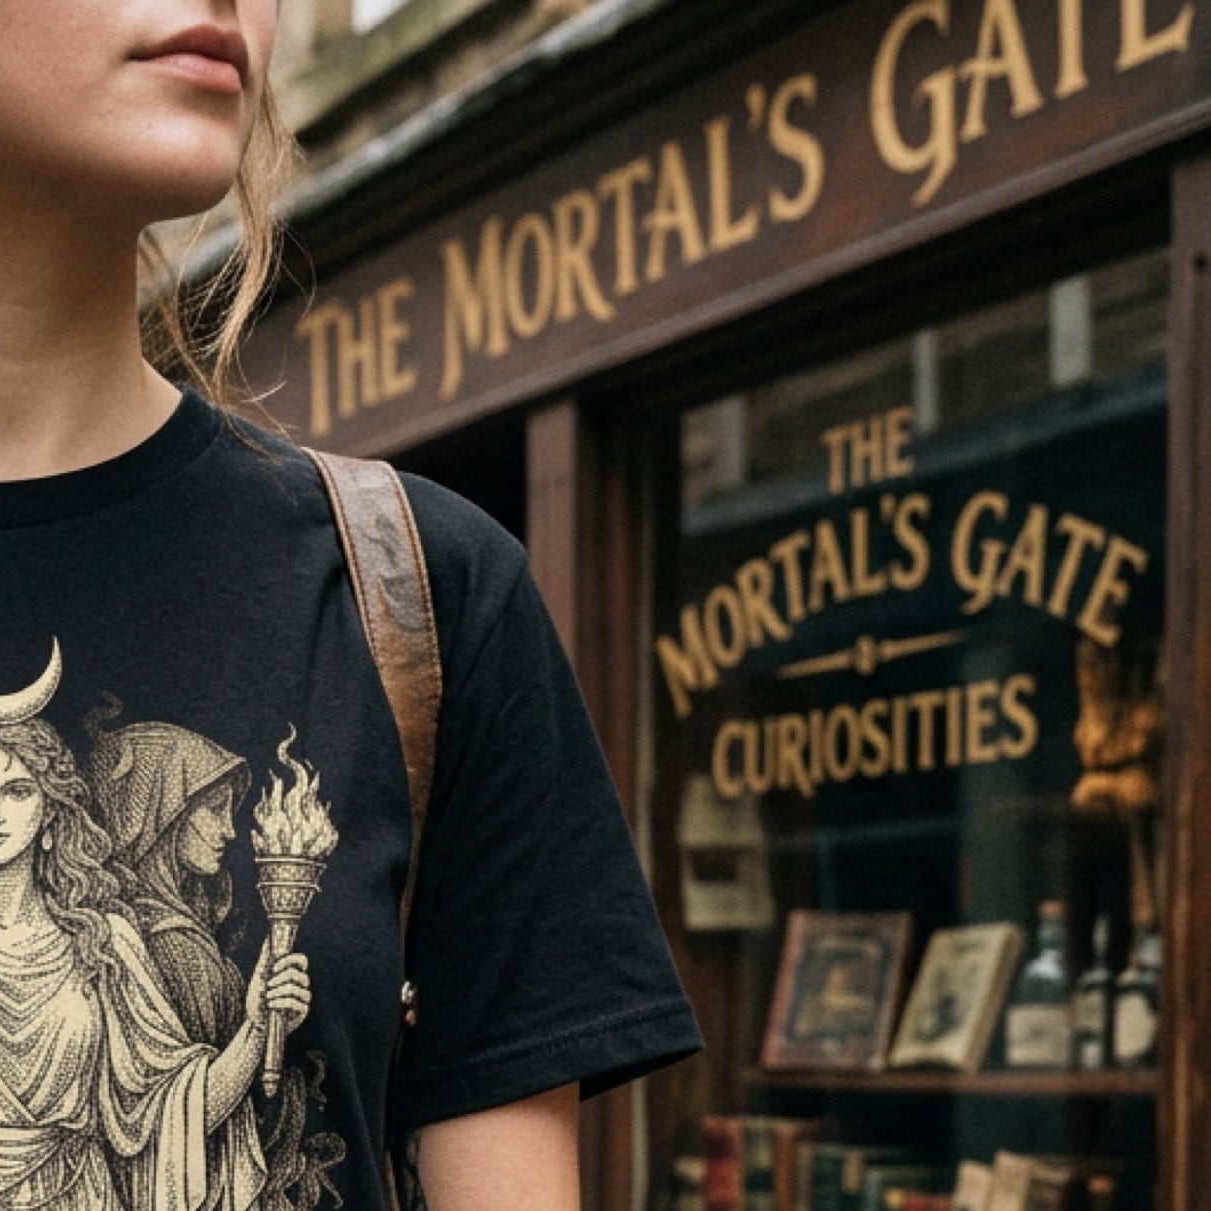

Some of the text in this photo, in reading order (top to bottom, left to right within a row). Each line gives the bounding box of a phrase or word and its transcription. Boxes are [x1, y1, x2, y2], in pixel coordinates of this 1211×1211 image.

[297, 277, 417, 436] THE
[438, 72, 826, 401] MORTAL'S
[822, 408, 915, 494] THE
[656, 491, 1149, 718] MORTAL'S GATE
[711, 674, 1038, 799] CURIOSITIES
